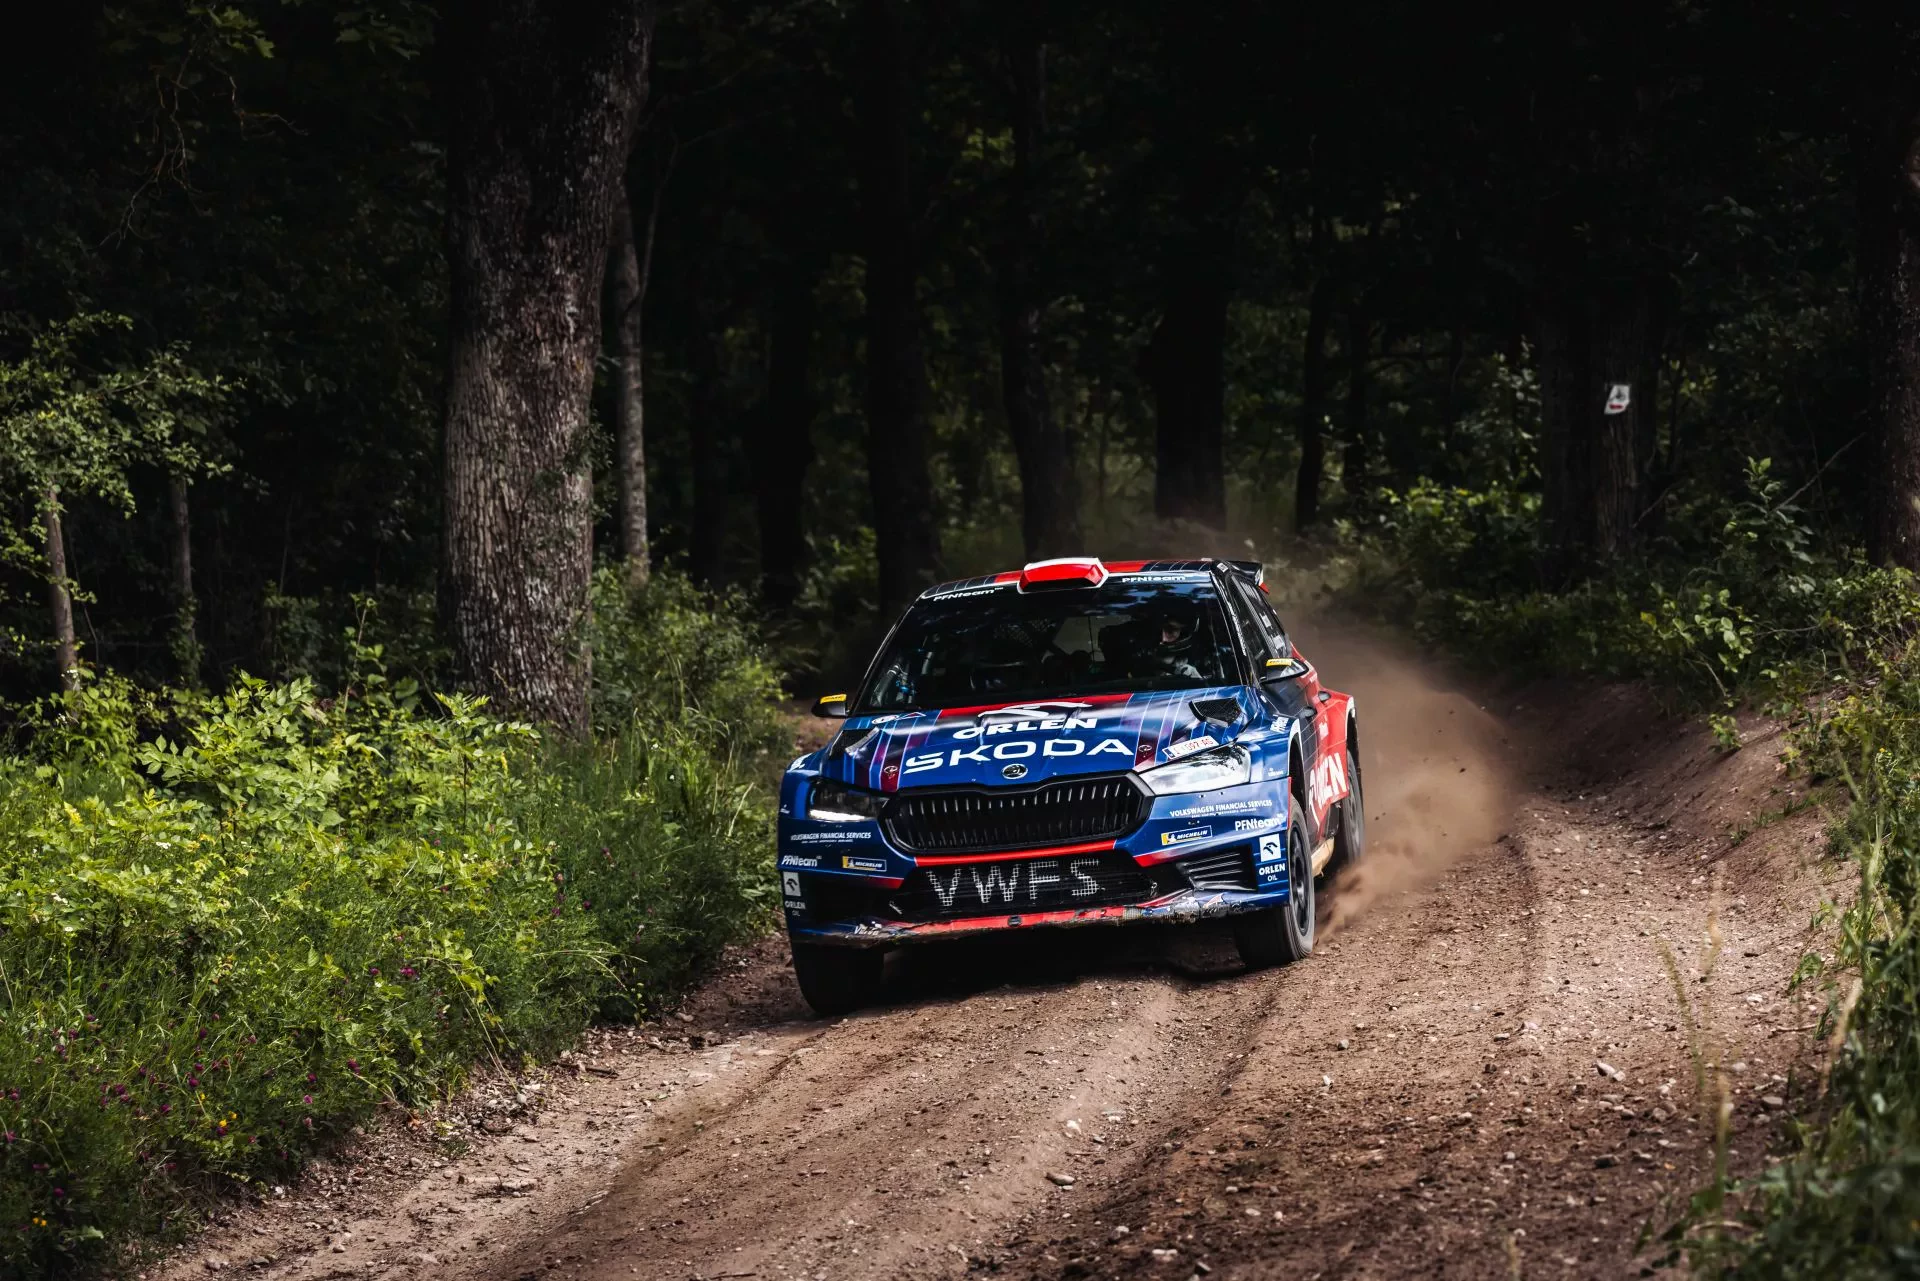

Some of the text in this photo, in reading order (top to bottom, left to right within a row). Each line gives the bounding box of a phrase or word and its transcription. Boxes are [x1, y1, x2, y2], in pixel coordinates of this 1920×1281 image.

[952, 718, 1098, 740] ORLEN
[1169, 805, 1214, 817] VOLKSWAGEN
[1215, 801, 1248, 812] FINANCIAL
[1248, 799, 1273, 809] SERVICES
[820, 832, 846, 840] FINANCIAL
[846, 831, 872, 839] SERVICES
[1176, 829, 1208, 840] MICHELIN
[1258, 863, 1286, 875] ORLEN
[926, 859, 1101, 907] VWFS
